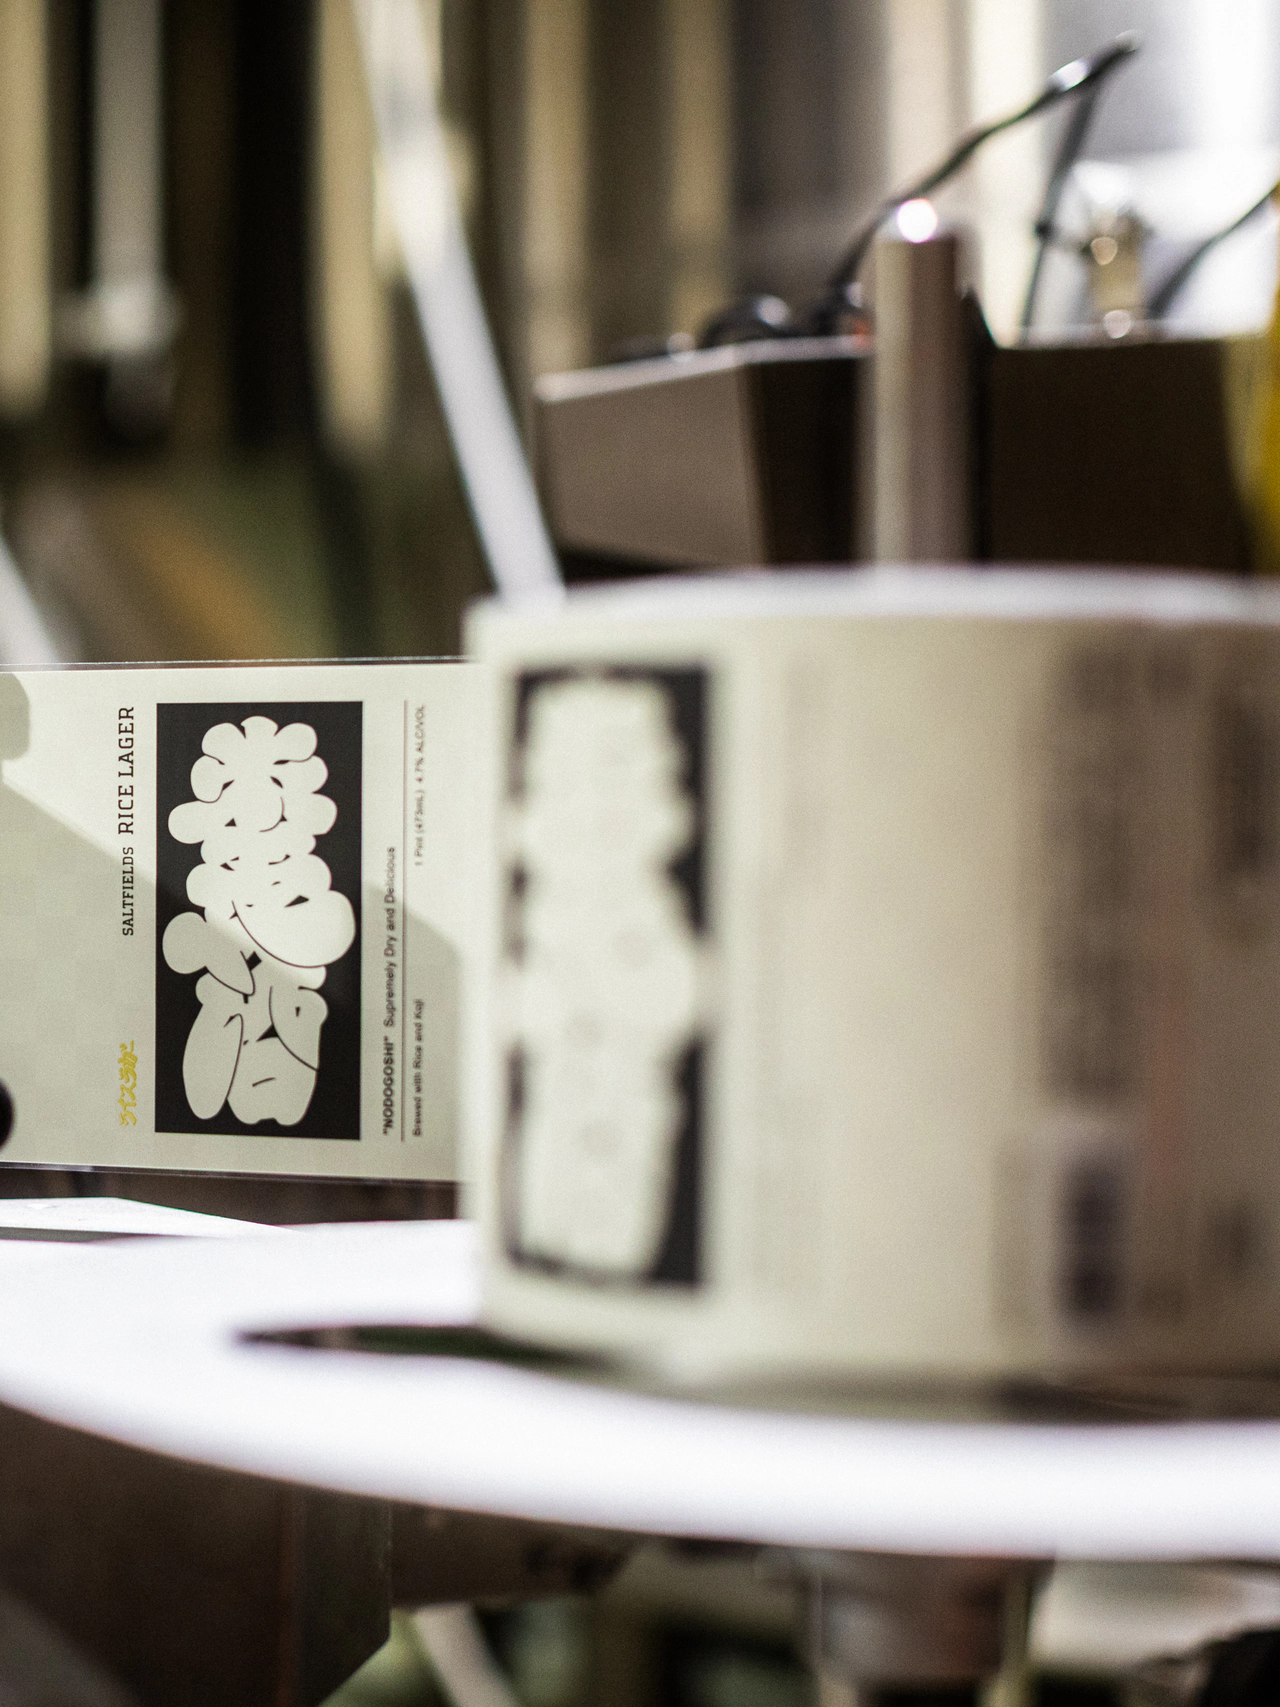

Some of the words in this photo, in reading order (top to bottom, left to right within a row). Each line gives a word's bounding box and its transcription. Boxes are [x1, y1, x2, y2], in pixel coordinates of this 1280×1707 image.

[118, 706, 135, 778] LAGER
[414, 704, 425, 754] ALC/VOL
[414, 757, 424, 783] 4.7%
[118, 784, 135, 836] RICE
[122, 846, 134, 937] SALTFIELDS
[384, 846, 396, 905] Delicious
[384, 908, 396, 931] and
[384, 934, 397, 958] Dry
[383, 961, 398, 1028] Supremely
[413, 1021, 423, 1042] and
[413, 1044, 423, 1070] Rice
[382, 1036, 395, 1136] "NODOGOSHI"
[412, 1072, 423, 1094] with
[412, 1096, 423, 1138] Brewed
